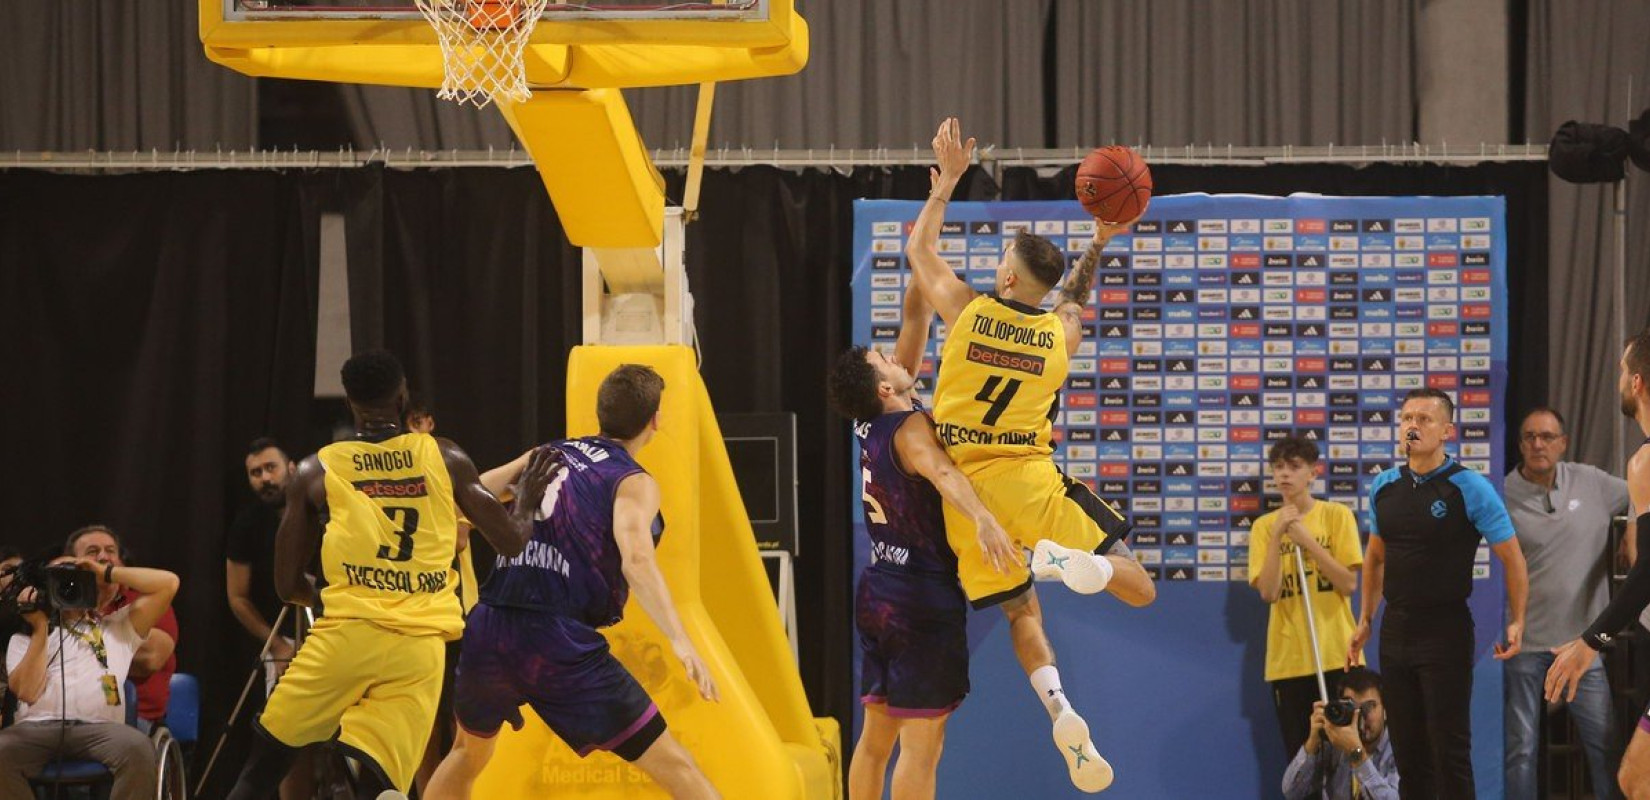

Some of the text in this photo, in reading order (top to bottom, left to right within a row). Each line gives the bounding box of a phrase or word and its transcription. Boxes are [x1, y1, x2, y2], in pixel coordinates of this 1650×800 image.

[972, 314, 1054, 349] TOLIOPOULOS
[969, 345, 1043, 373] betsson
[974, 375, 1024, 427] 4
[862, 468, 888, 525] 5
[376, 506, 420, 562] 3
[542, 764, 621, 784] Medical
